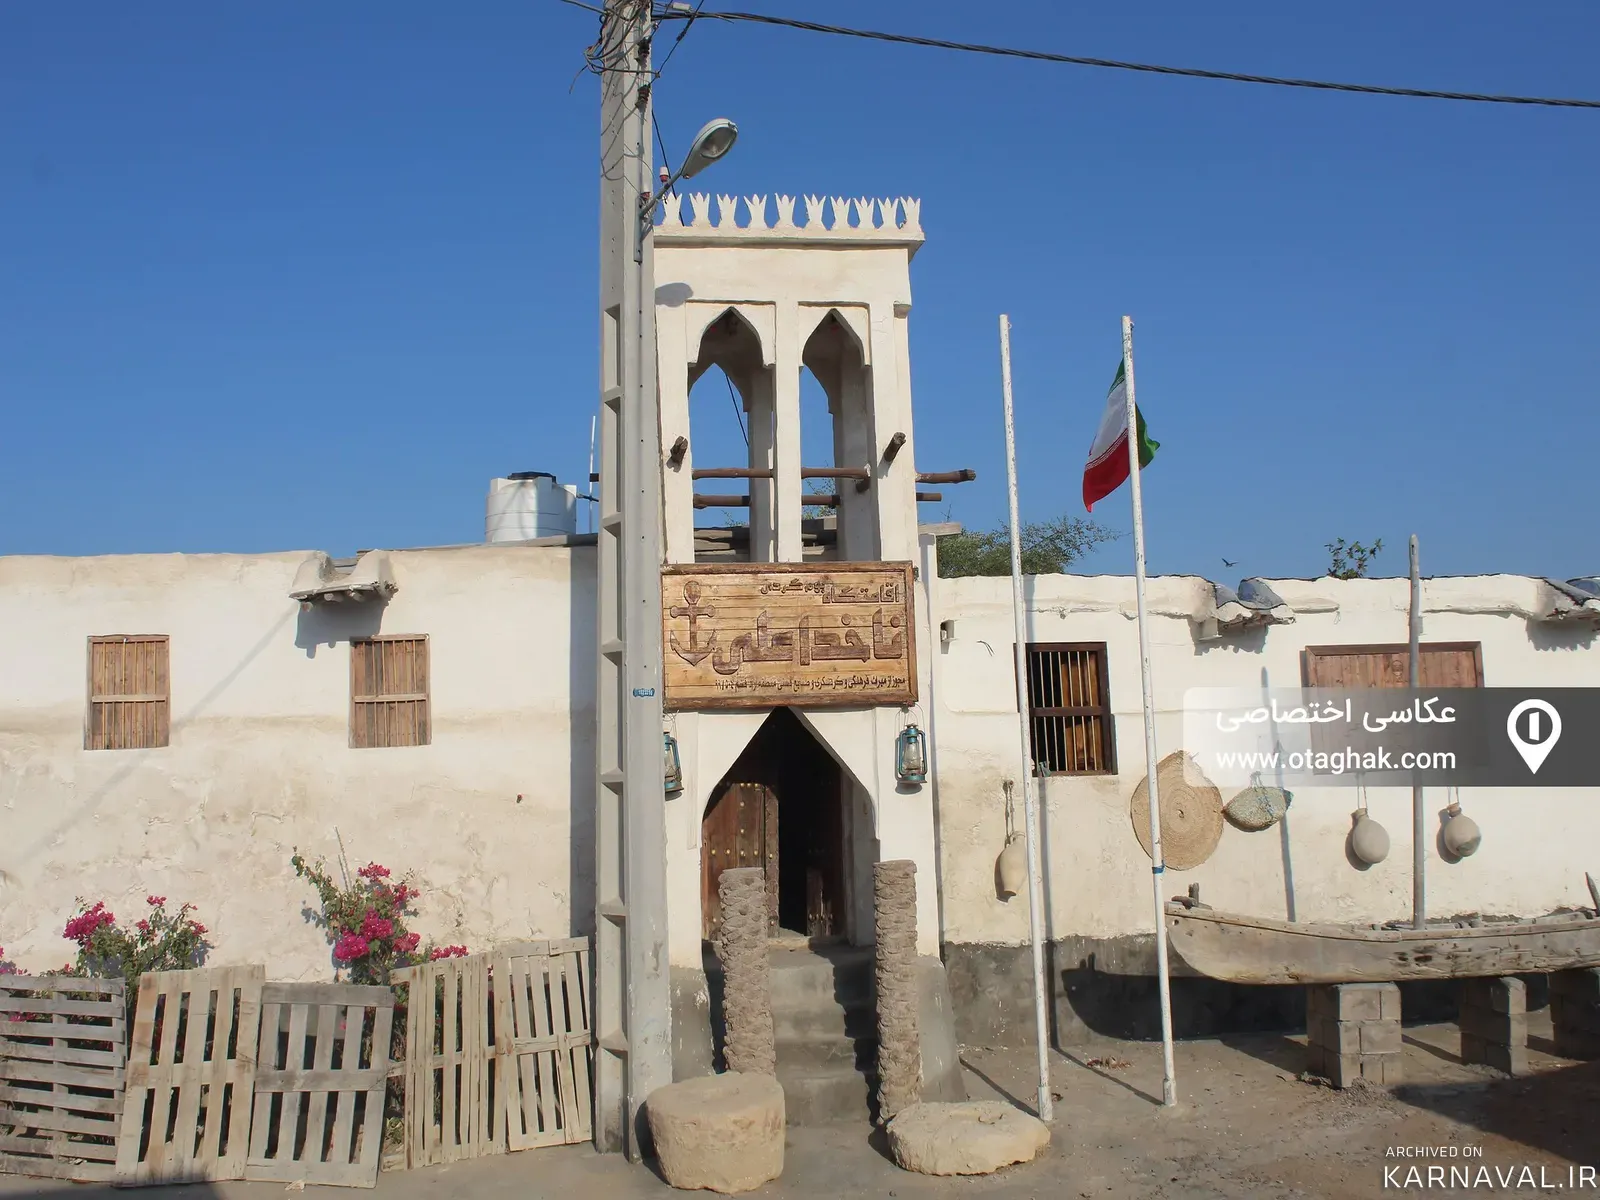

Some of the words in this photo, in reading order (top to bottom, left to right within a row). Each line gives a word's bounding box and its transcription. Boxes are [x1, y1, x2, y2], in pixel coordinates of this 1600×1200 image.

[804, 580, 826, 594] بوم
[821, 582, 900, 605] اقامتگاه
[712, 609, 794, 676] علی
[798, 607, 903, 667] ناخدا
